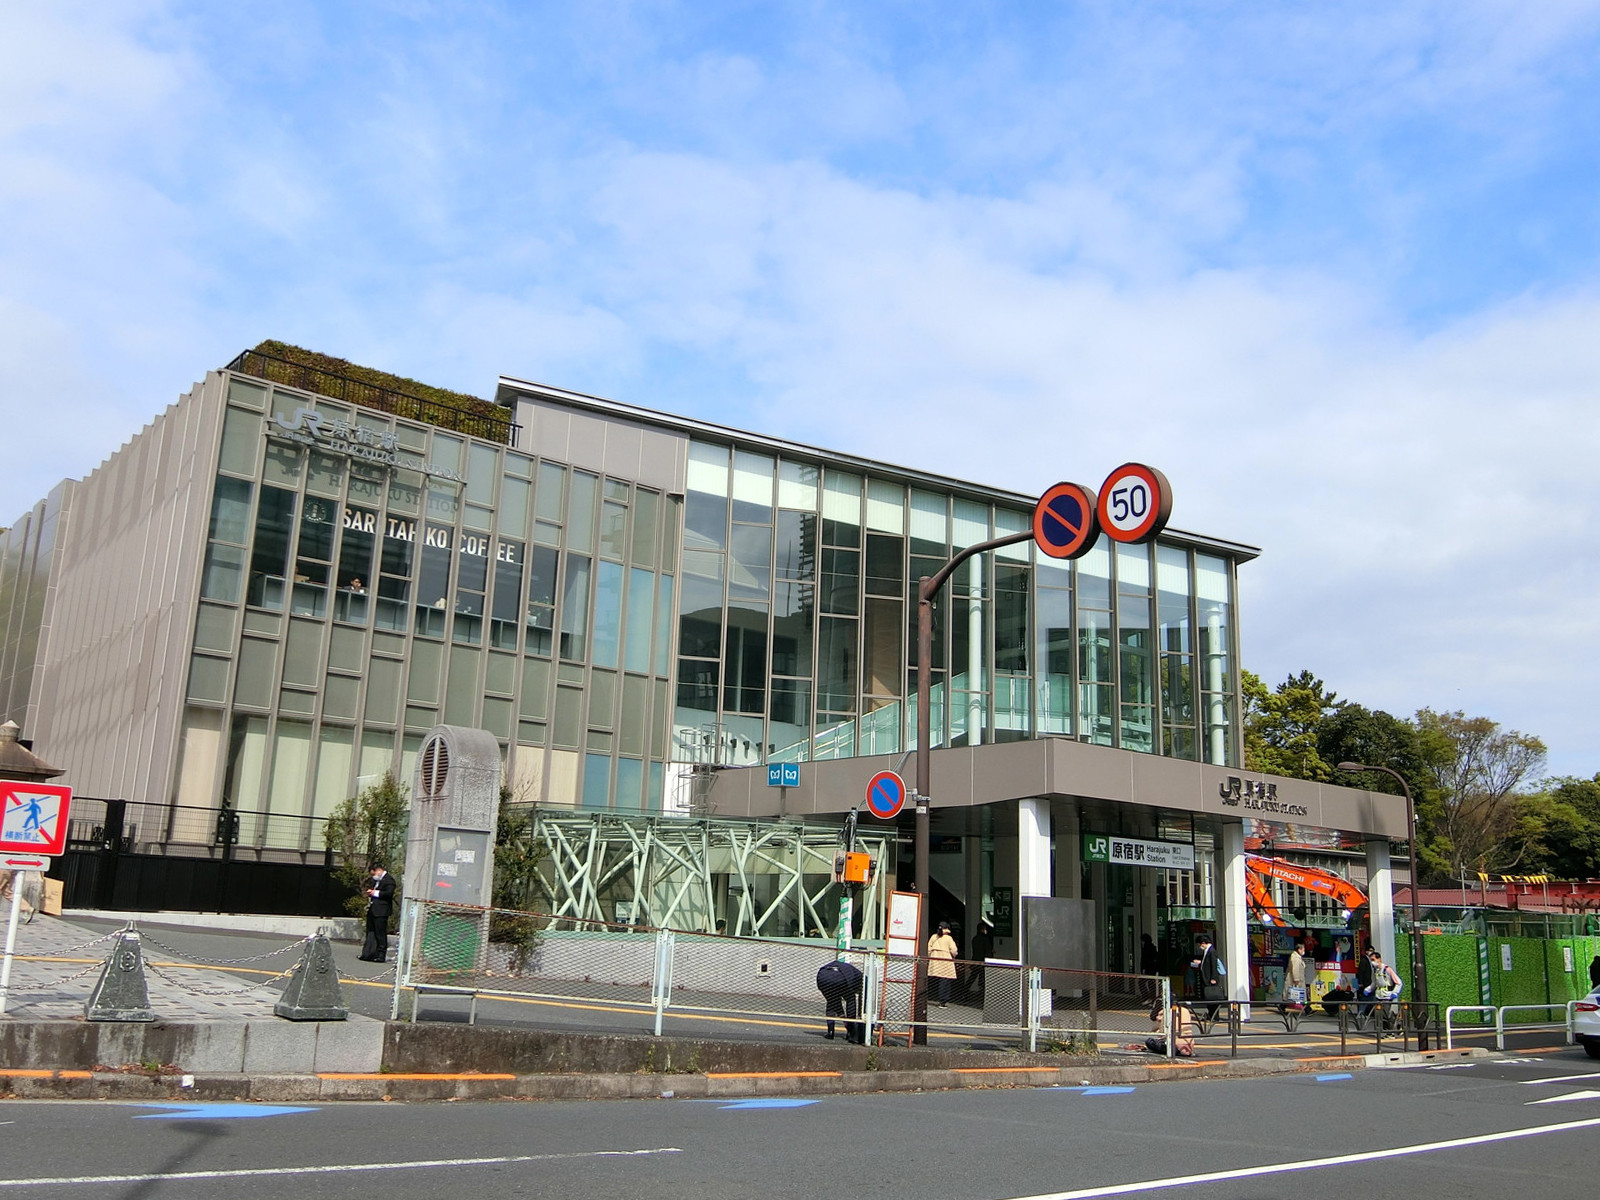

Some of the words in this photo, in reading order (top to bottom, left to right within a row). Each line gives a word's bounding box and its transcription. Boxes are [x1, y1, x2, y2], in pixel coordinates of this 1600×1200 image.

[277, 407, 324, 438] JR
[1112, 484, 1147, 521] 50
[342, 508, 448, 549] SARTAHKO
[460, 533, 515, 563] COFEE
[1219, 776, 1241, 800] JR
[5, 830, 40, 842] 横断禁止
[1089, 838, 1106, 853] JR
[1112, 841, 1145, 861] 原宿駅
[1146, 845, 1171, 855] Harajuku
[1147, 853, 1166, 863] Station
[1269, 866, 1305, 882] HITACHI
